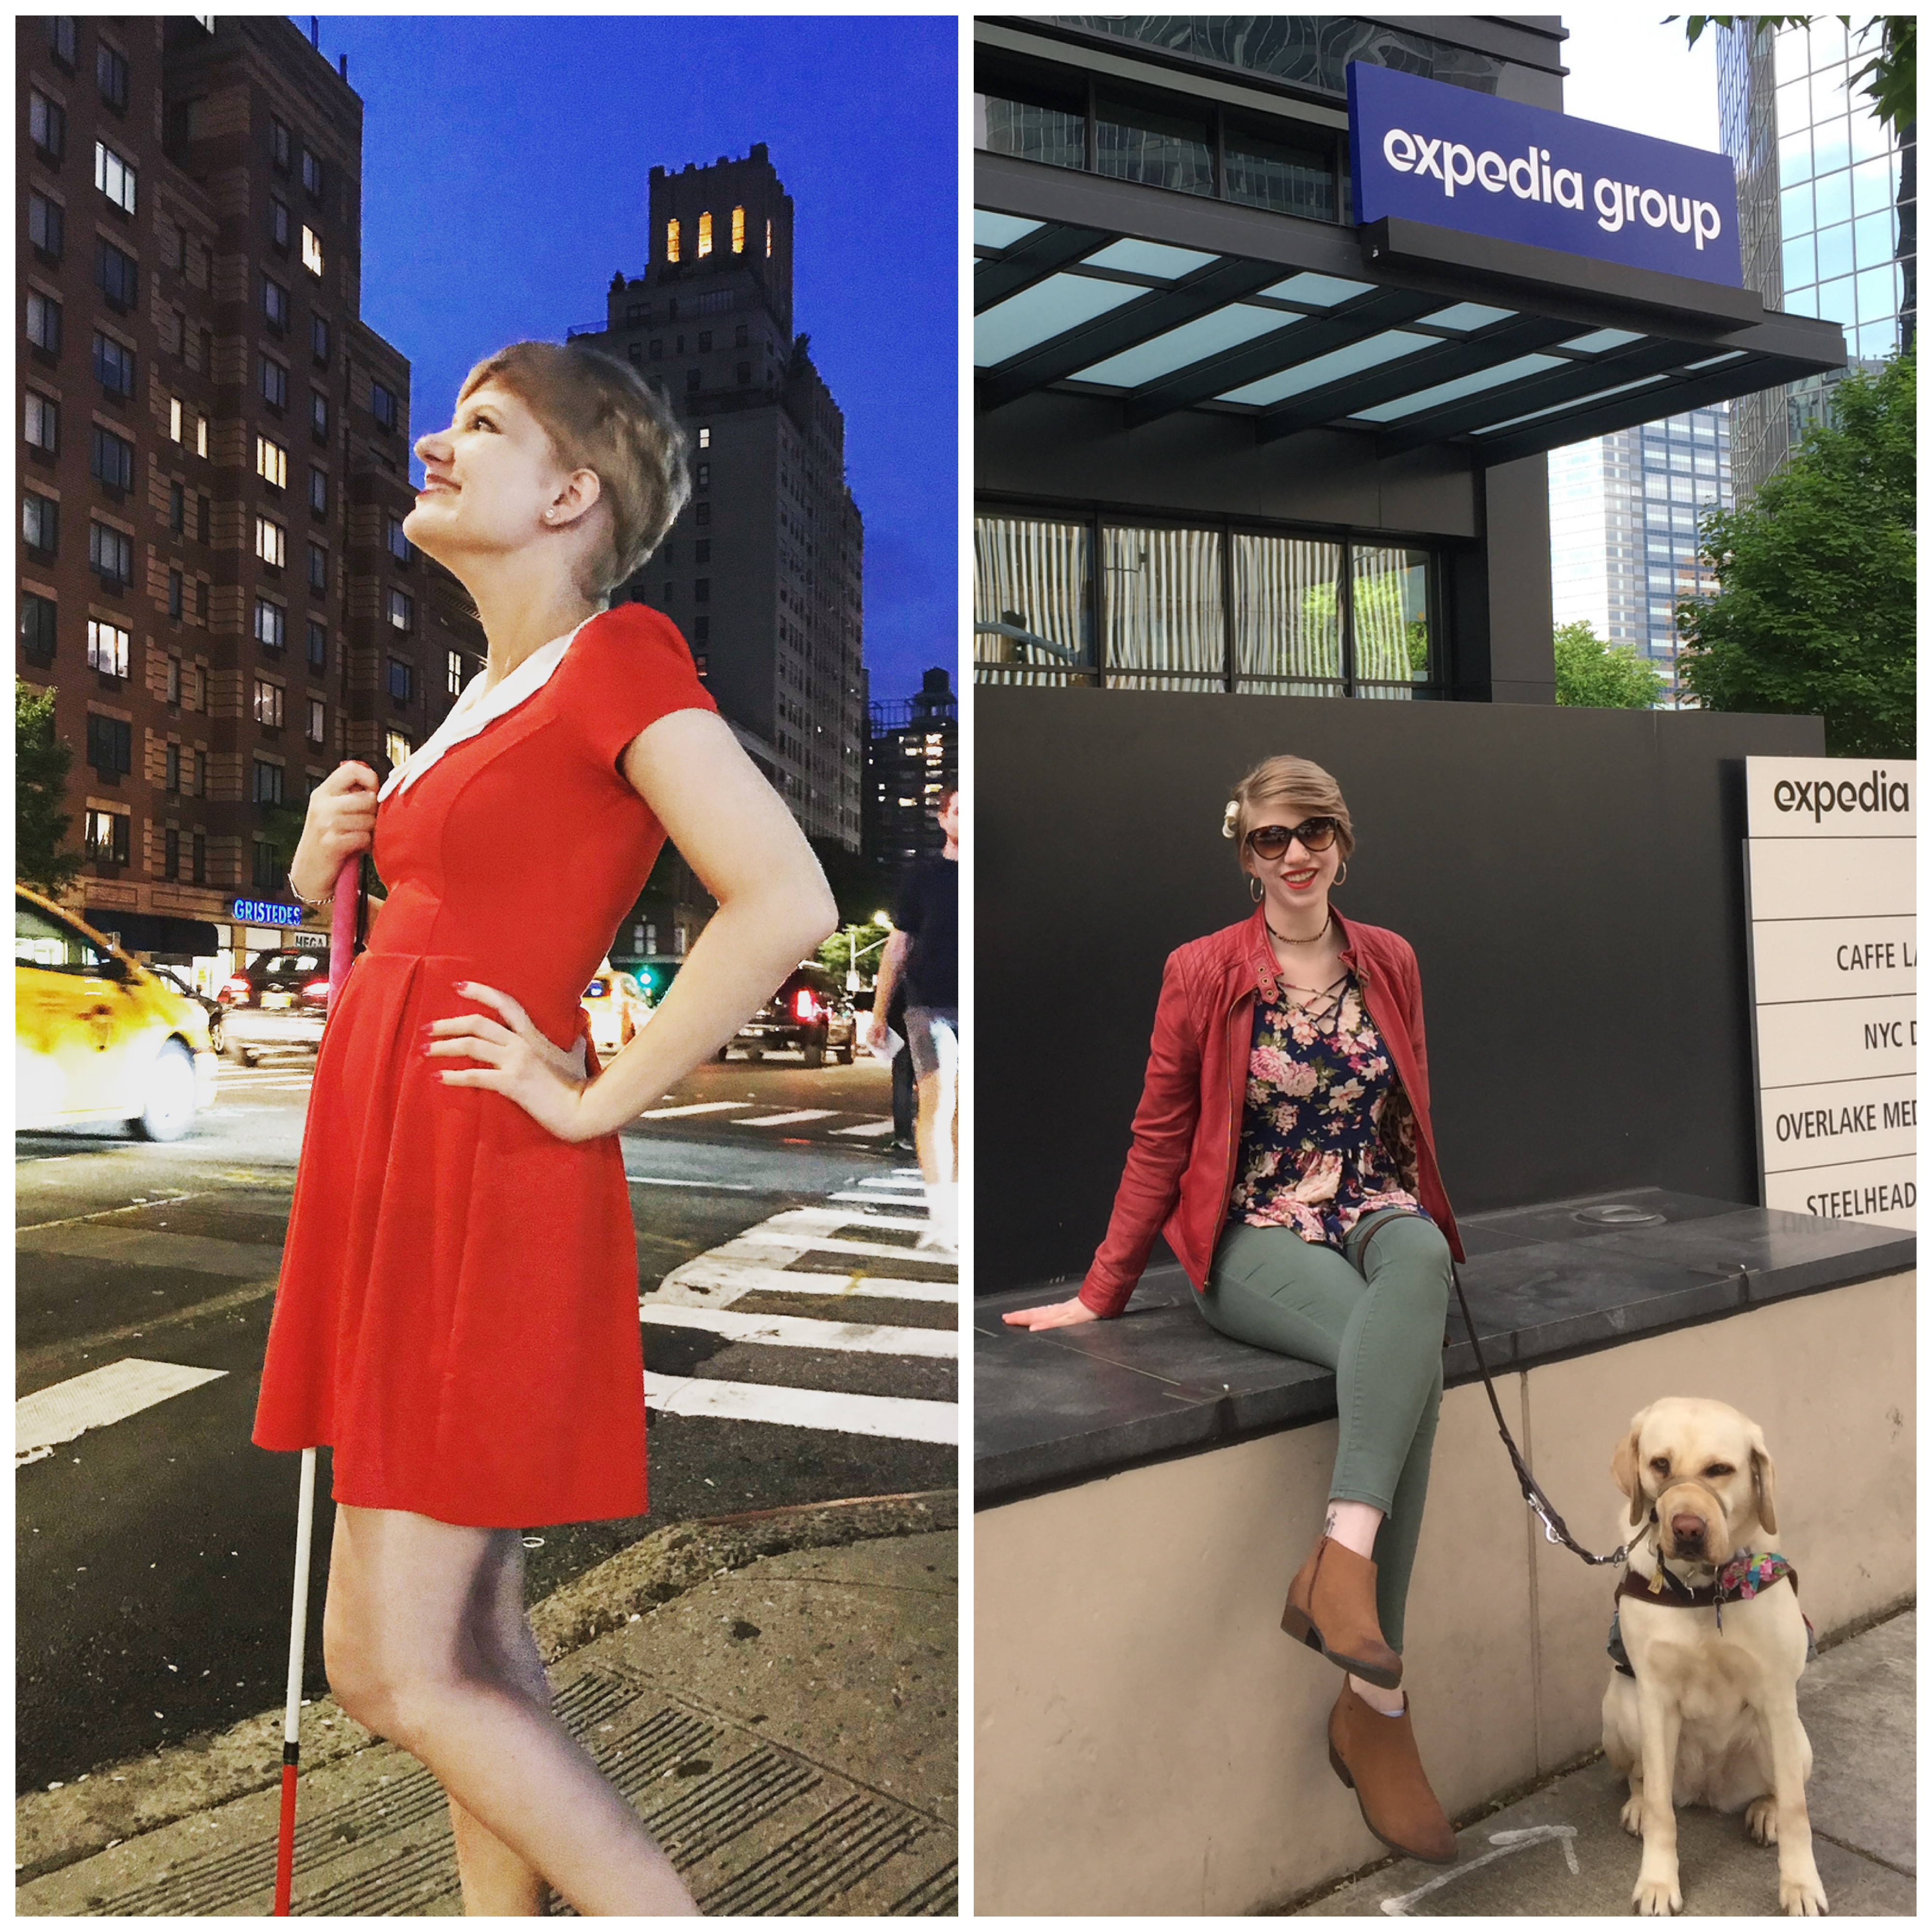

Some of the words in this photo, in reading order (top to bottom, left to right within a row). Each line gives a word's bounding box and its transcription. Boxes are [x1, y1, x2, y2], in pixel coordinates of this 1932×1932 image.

[1383, 128, 1584, 210] expedia
[1594, 177, 1721, 250] group
[1774, 769, 1909, 824] expedia
[234, 898, 301, 926] GRISTEDES
[1837, 943, 1896, 971] CAFFE
[1904, 942, 1917, 967] L
[1864, 1022, 1903, 1050] NYC
[1776, 1104, 1877, 1142] OVERLAKE
[1806, 1182, 1917, 1219] STEELHEAD
